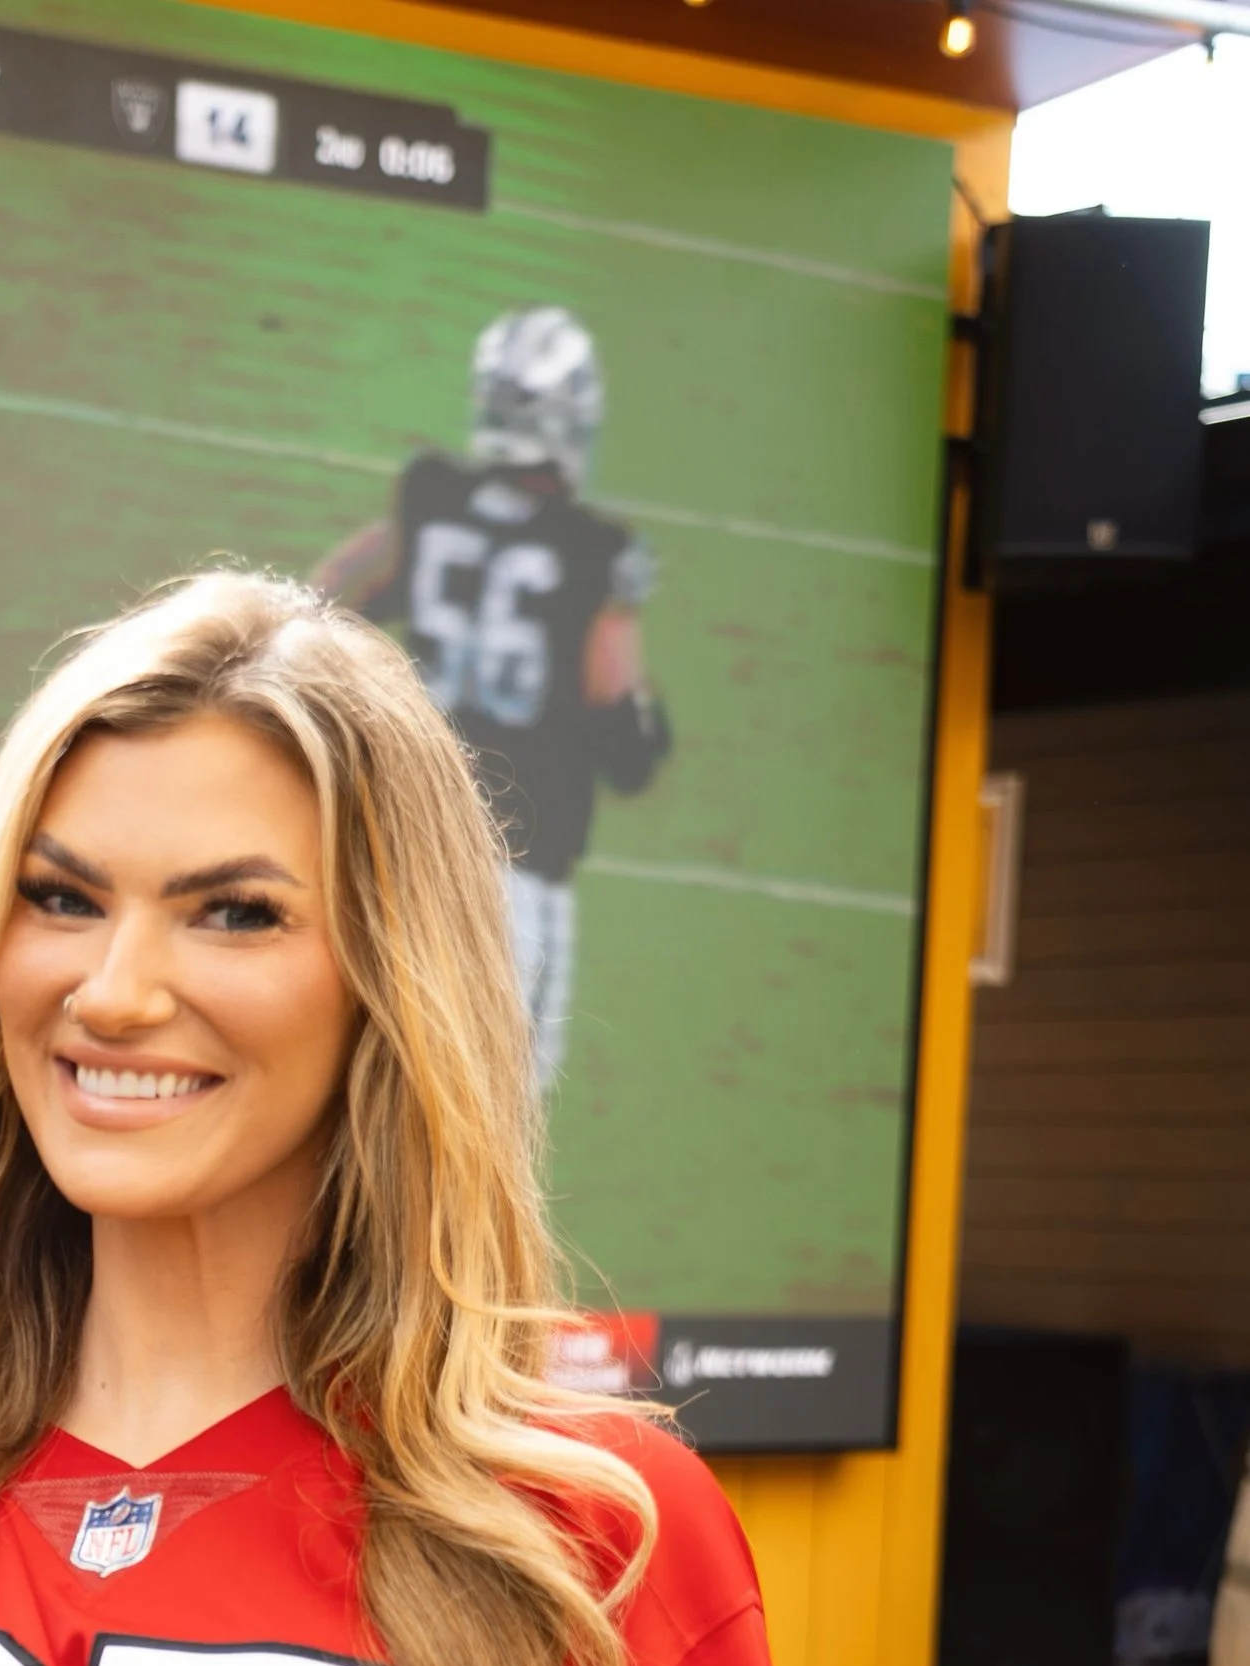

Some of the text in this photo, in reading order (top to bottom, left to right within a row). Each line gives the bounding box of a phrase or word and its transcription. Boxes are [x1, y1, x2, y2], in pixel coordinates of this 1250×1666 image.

[204, 105, 255, 149] 14
[410, 523, 562, 728] 56
[85, 1527, 140, 1562] NFL
